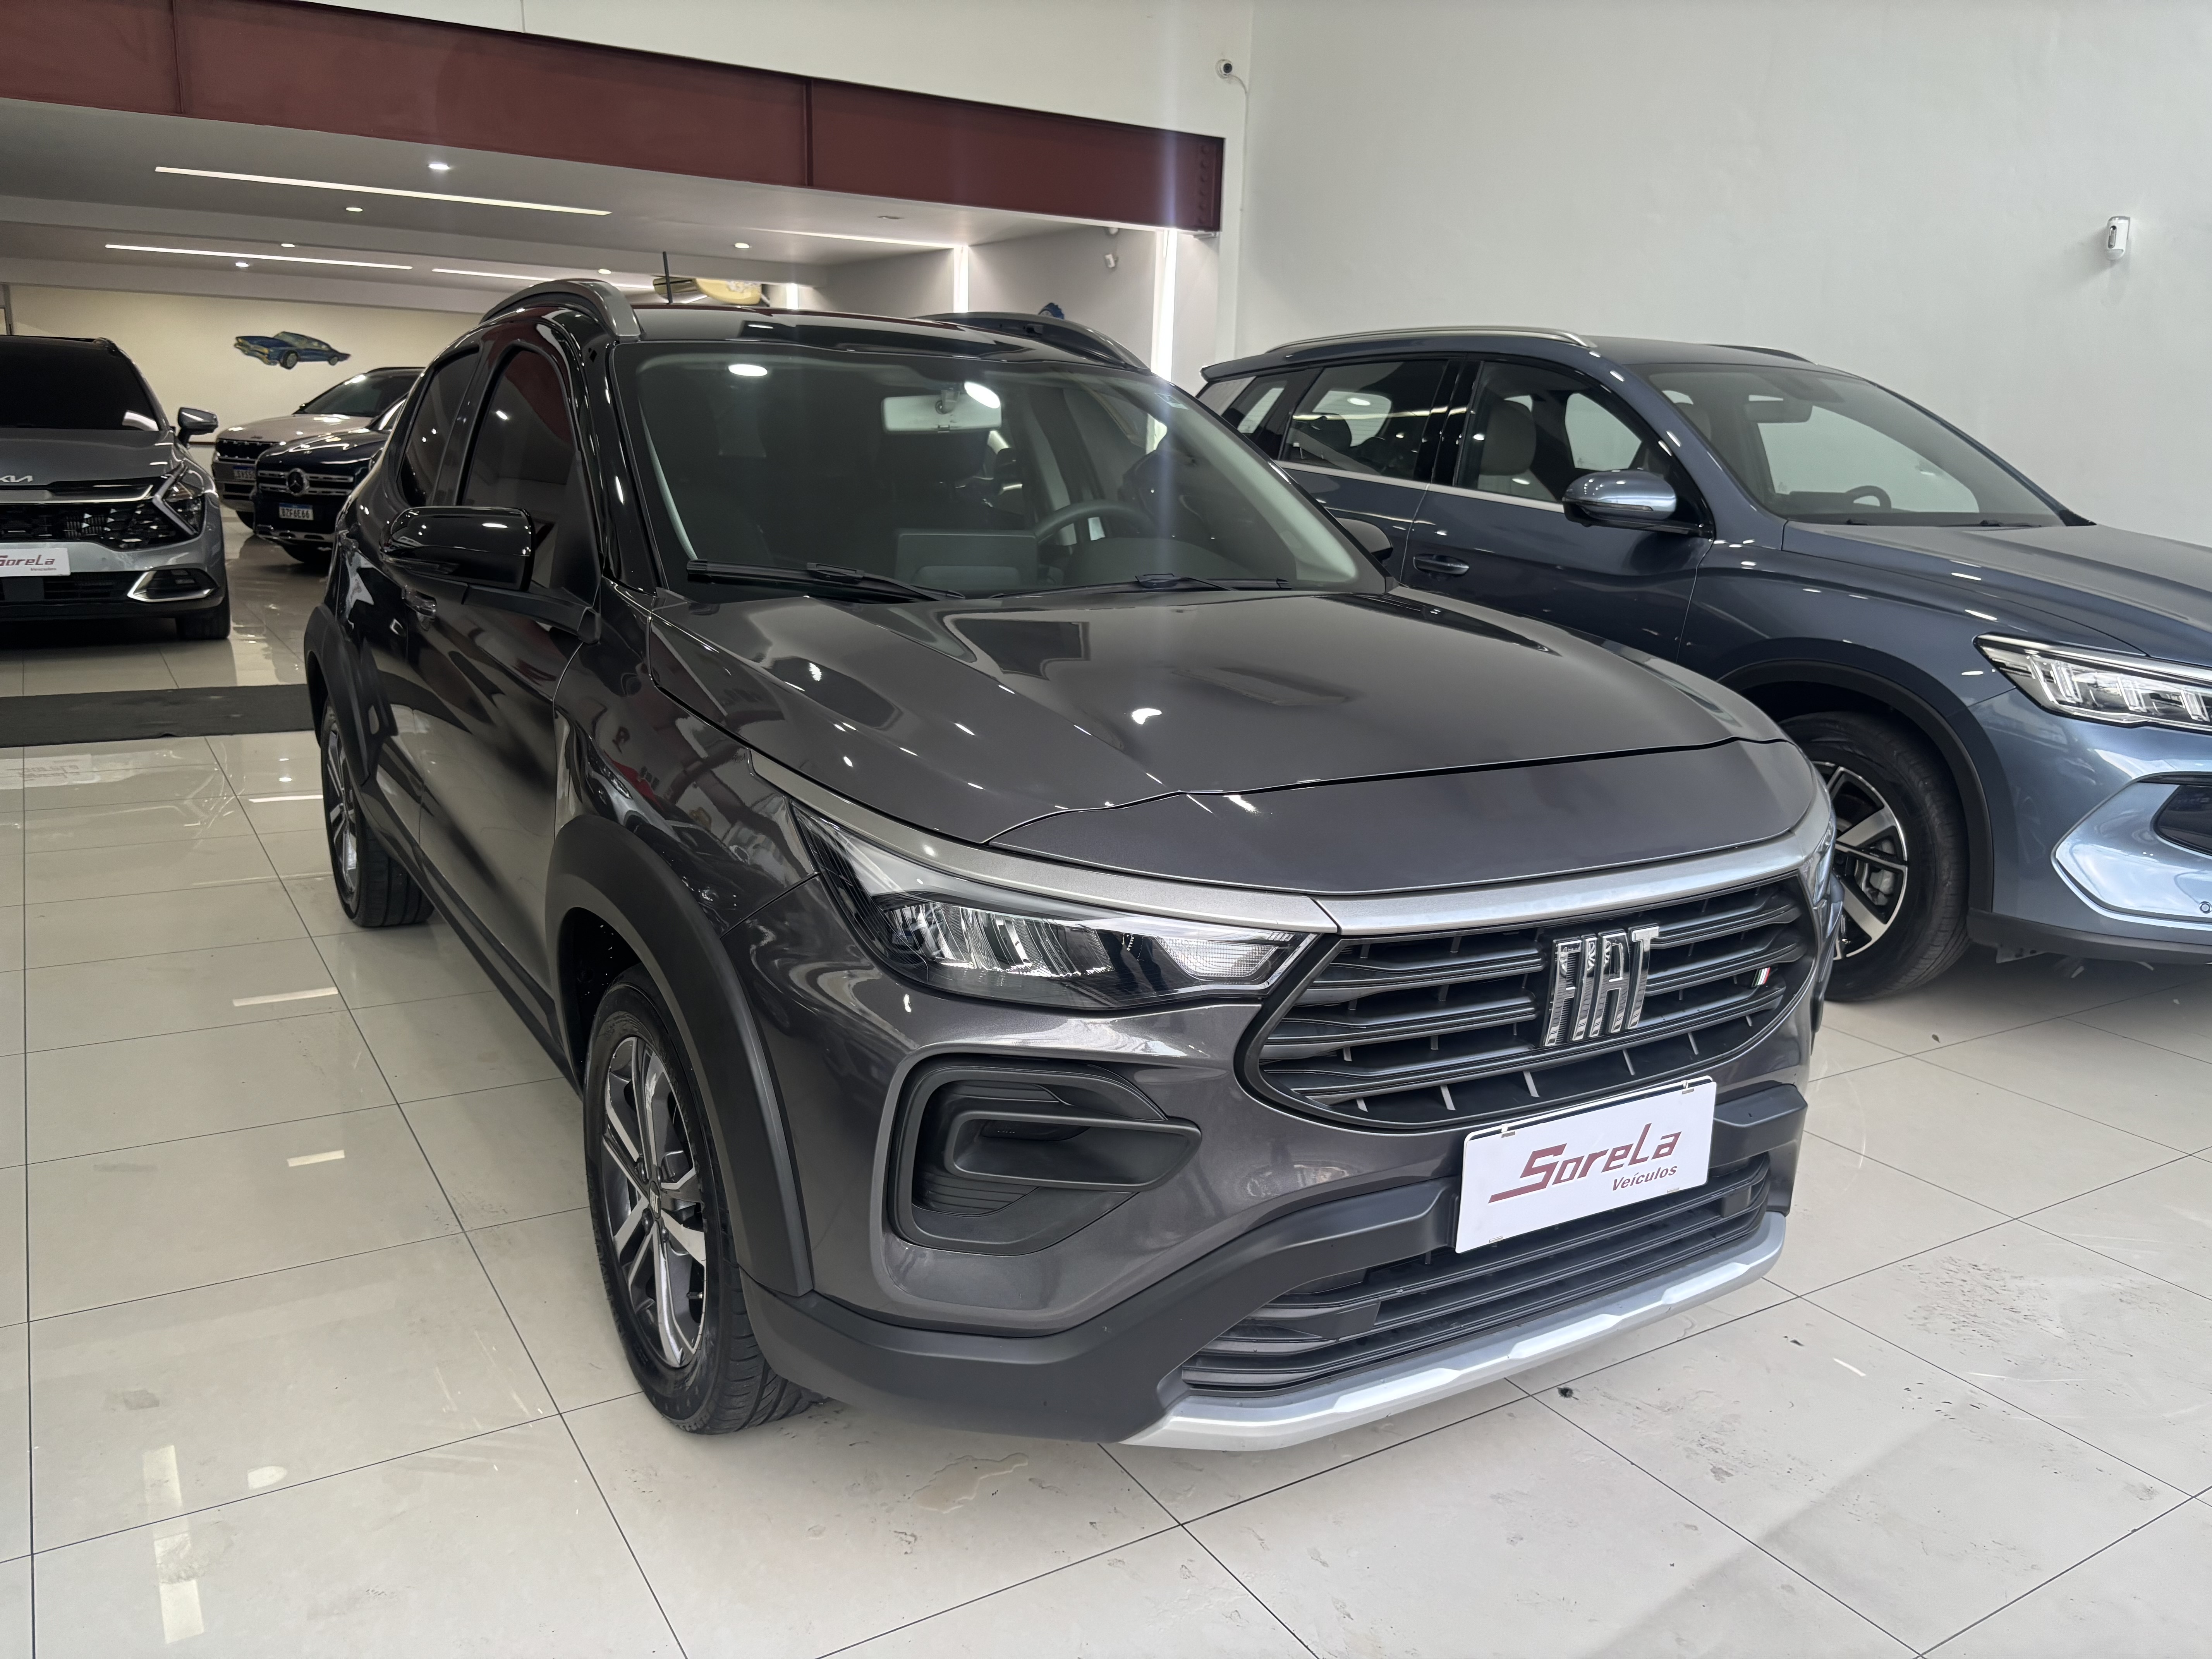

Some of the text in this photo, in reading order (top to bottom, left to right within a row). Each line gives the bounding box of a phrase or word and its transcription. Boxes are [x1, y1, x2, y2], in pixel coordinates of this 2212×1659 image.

[1544, 926, 1659, 1047] FIAT
[1488, 1123, 1681, 1203] SoreLa
[1613, 1166, 1678, 1191] Veículos
